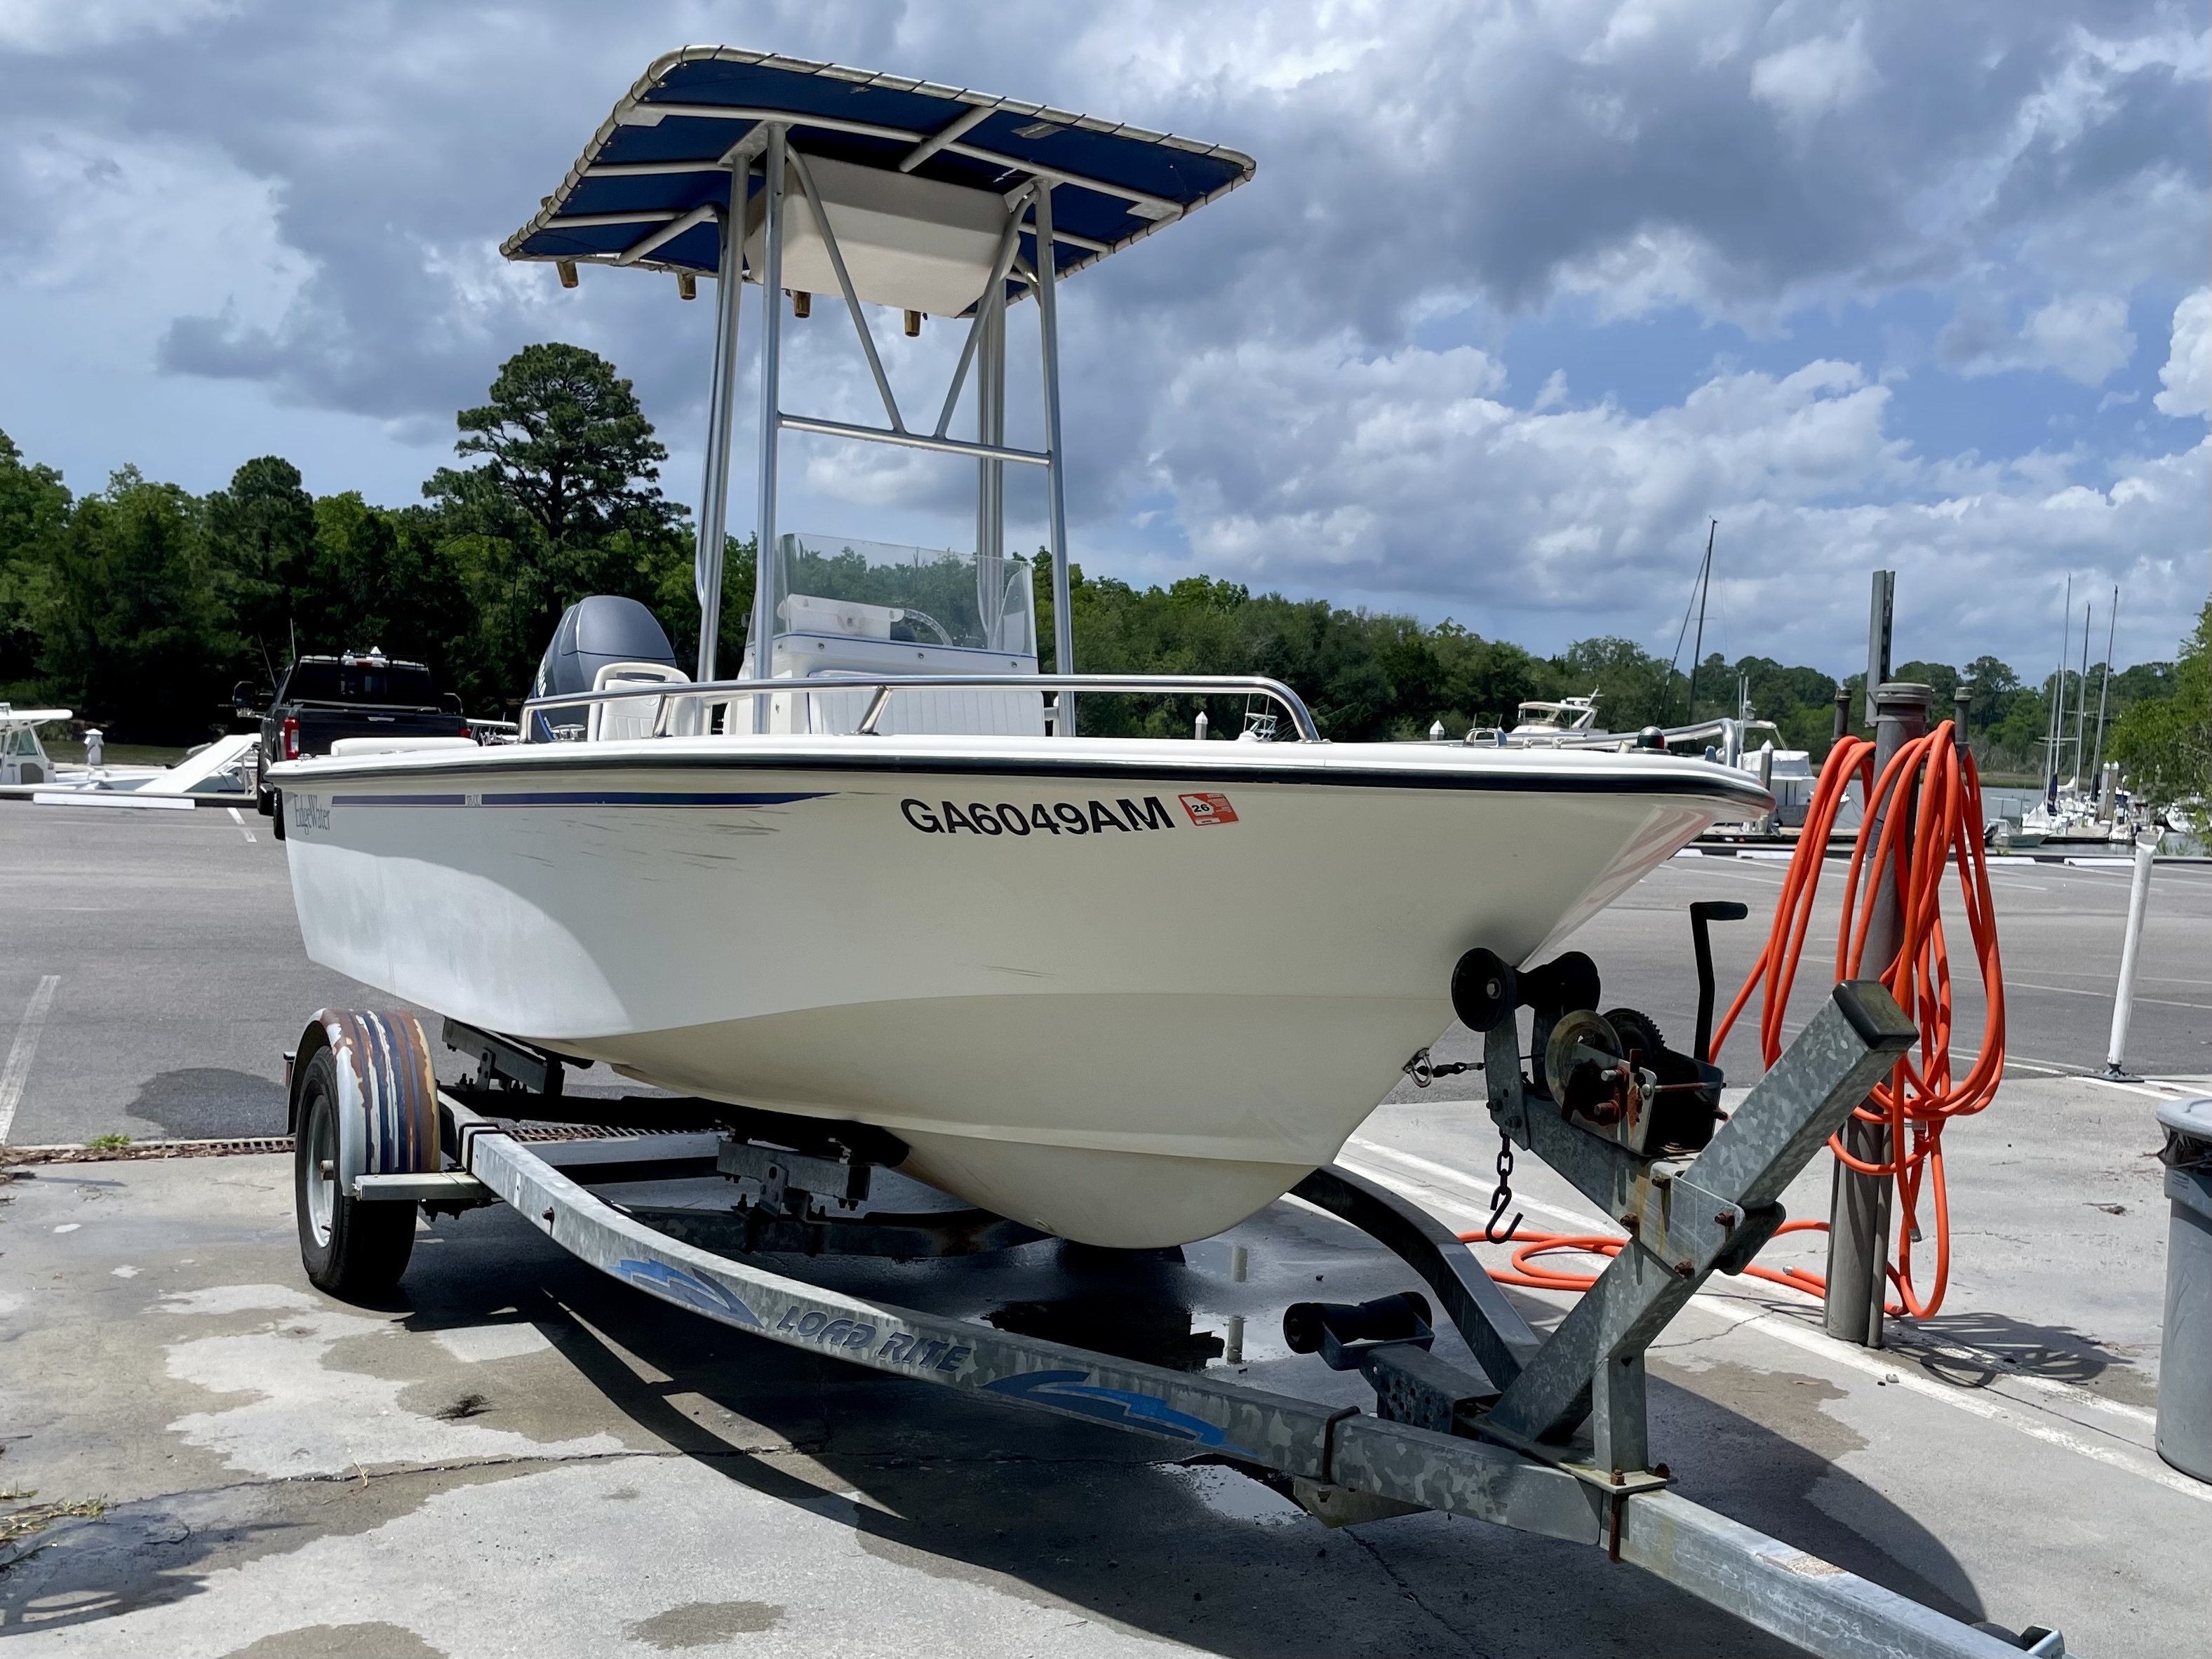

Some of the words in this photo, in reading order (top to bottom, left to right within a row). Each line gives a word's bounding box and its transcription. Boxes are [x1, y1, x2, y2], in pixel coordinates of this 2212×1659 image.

[294, 795, 330, 835] EdgeWater
[901, 796, 1176, 835] GA6049AM
[1191, 803, 1210, 813] 26
[777, 1305, 877, 1350] LOAD
[878, 1331, 972, 1373] RITE
